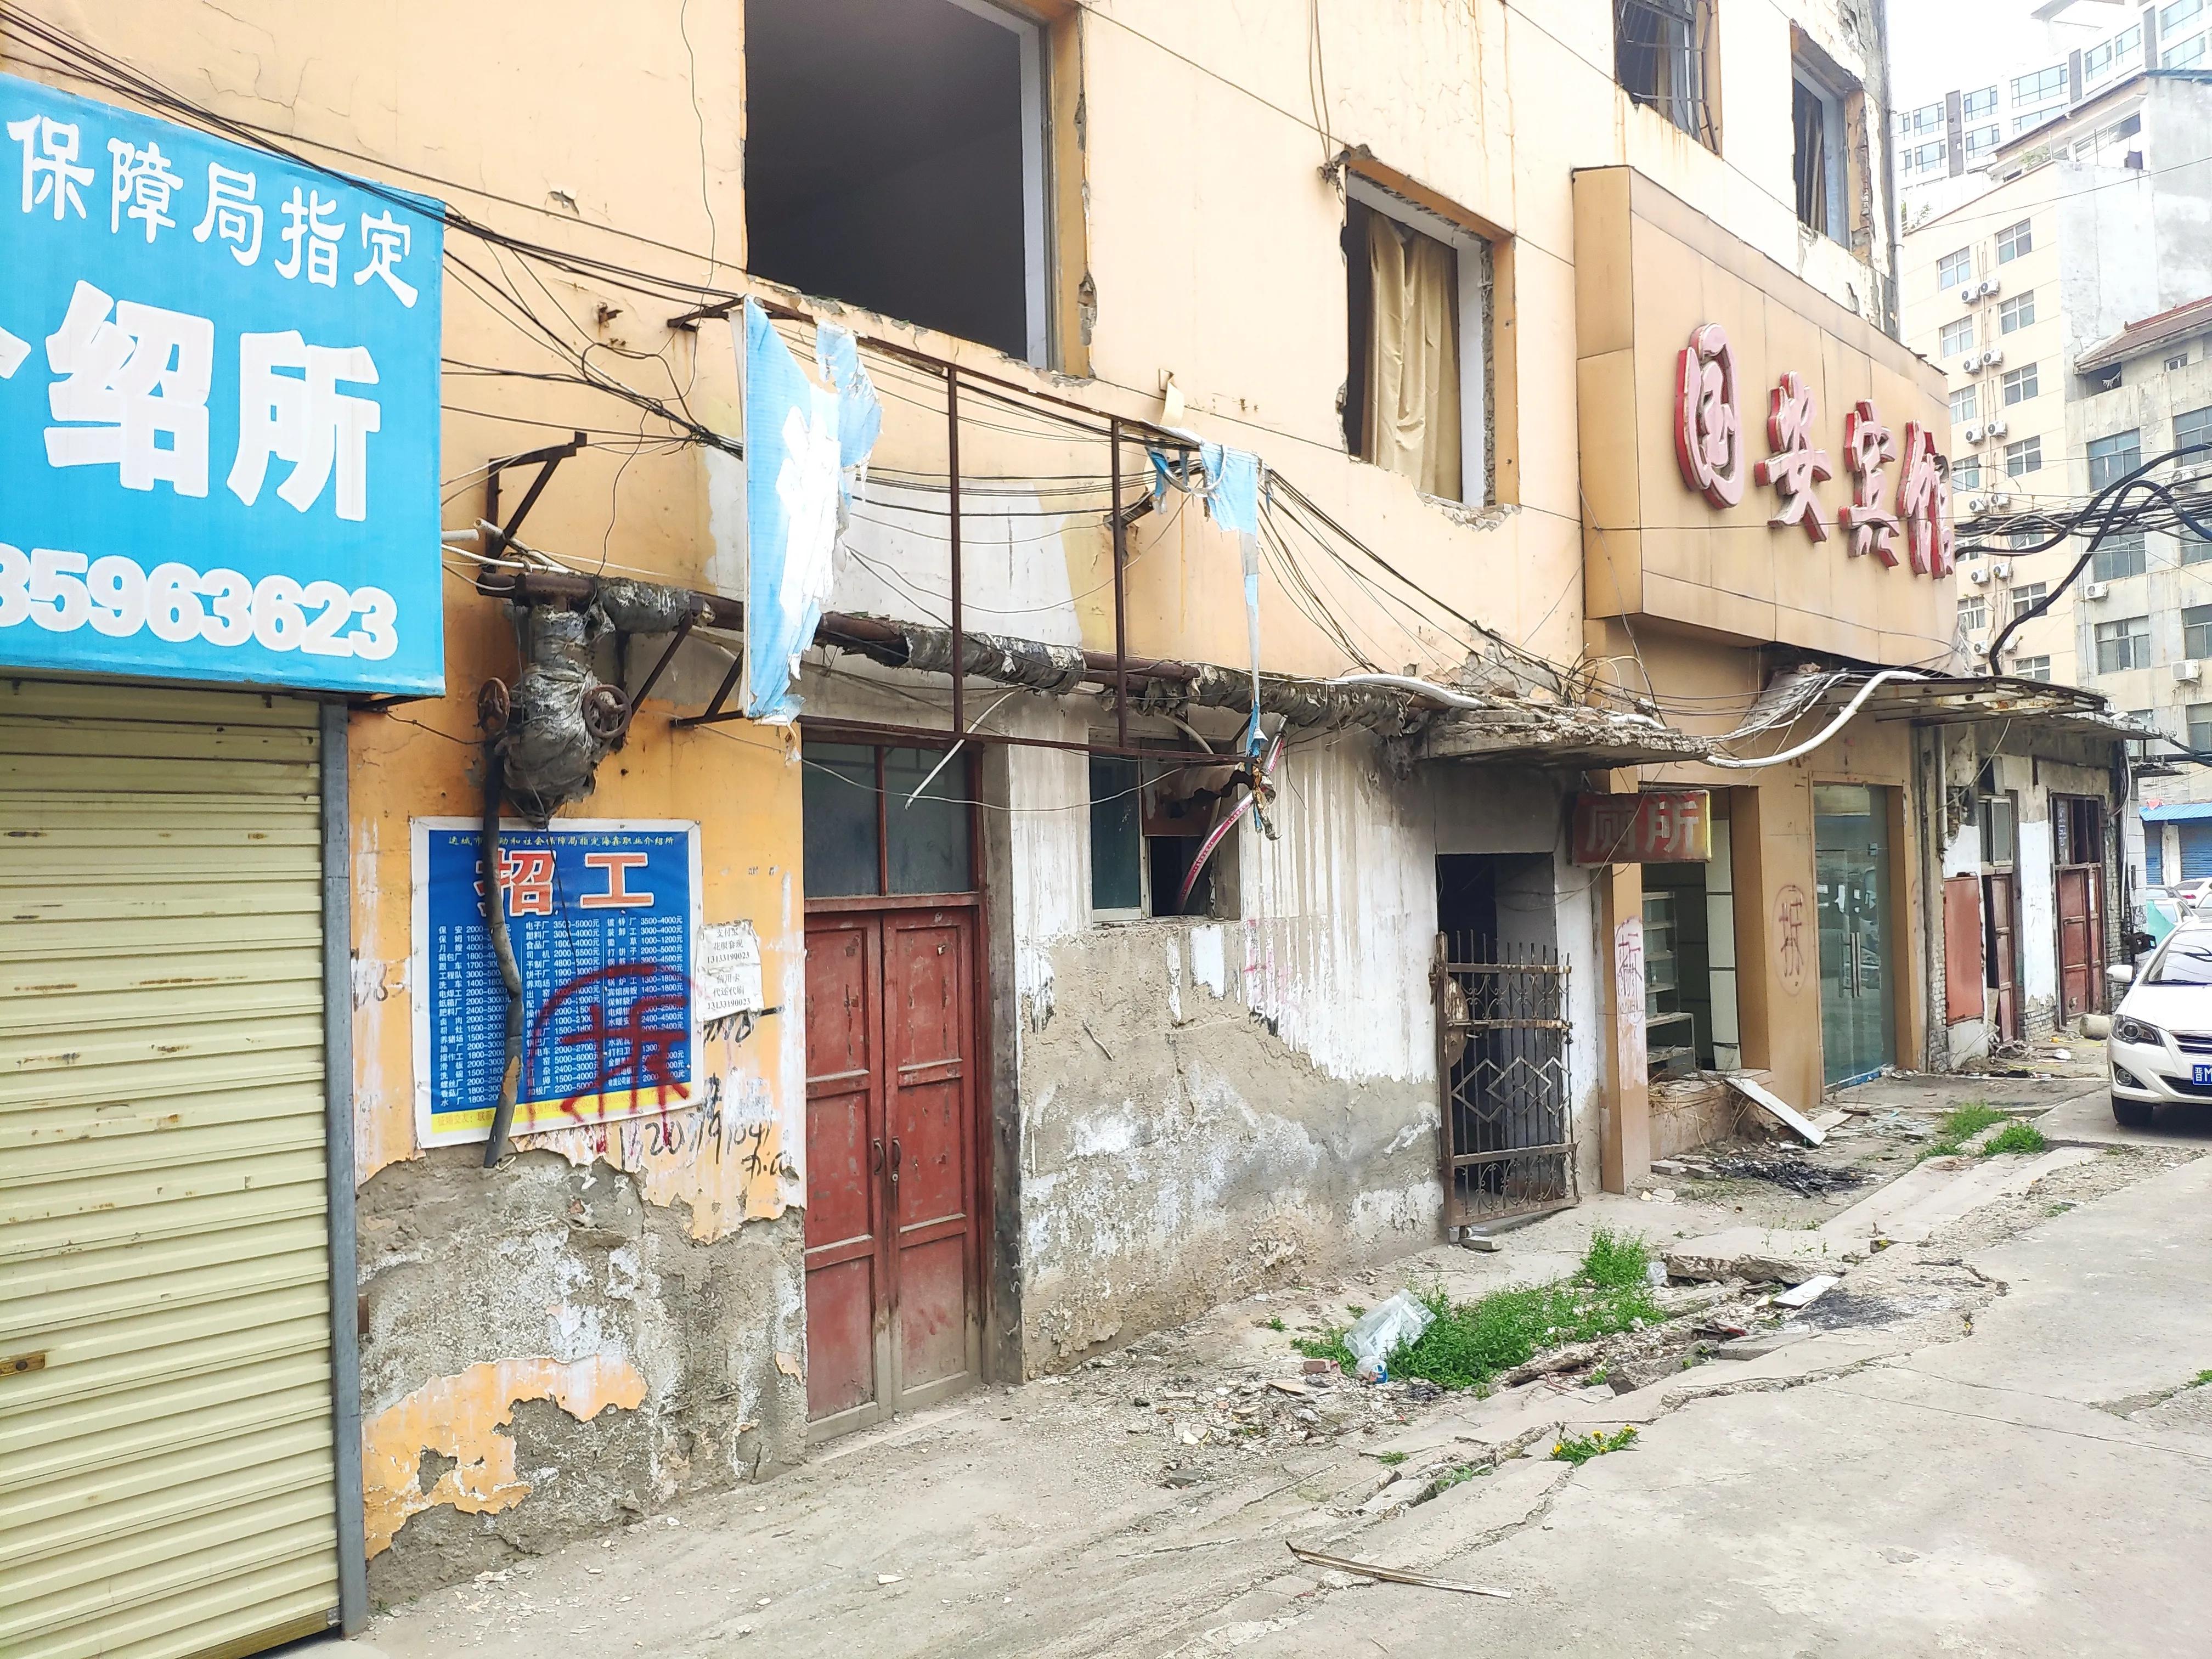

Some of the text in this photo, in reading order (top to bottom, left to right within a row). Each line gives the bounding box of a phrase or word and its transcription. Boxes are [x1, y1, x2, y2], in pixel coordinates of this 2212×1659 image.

[7, 114, 419, 308] 保障局指定
[0, 279, 381, 522] 绍所
[1586, 800, 1699, 853] 厕所
[473, 848, 654, 917] 招工
[526, 921, 549, 930] 电子厂
[641, 916, 683, 925] 3500-4000元
[526, 930, 549, 940] 塑料厂
[641, 925, 683, 935] 3000-4000元
[526, 940, 549, 950] 食品厂
[641, 935, 683, 945] 1000-1200元
[641, 944, 683, 955] 2000-5000元
[526, 950, 549, 960] 司机
[707, 952, 750, 964] 13133190023
[527, 969, 550, 979] 饼干厂
[707, 998, 751, 1009] 13133190023
[441, 1097, 464, 1107] 水厂
